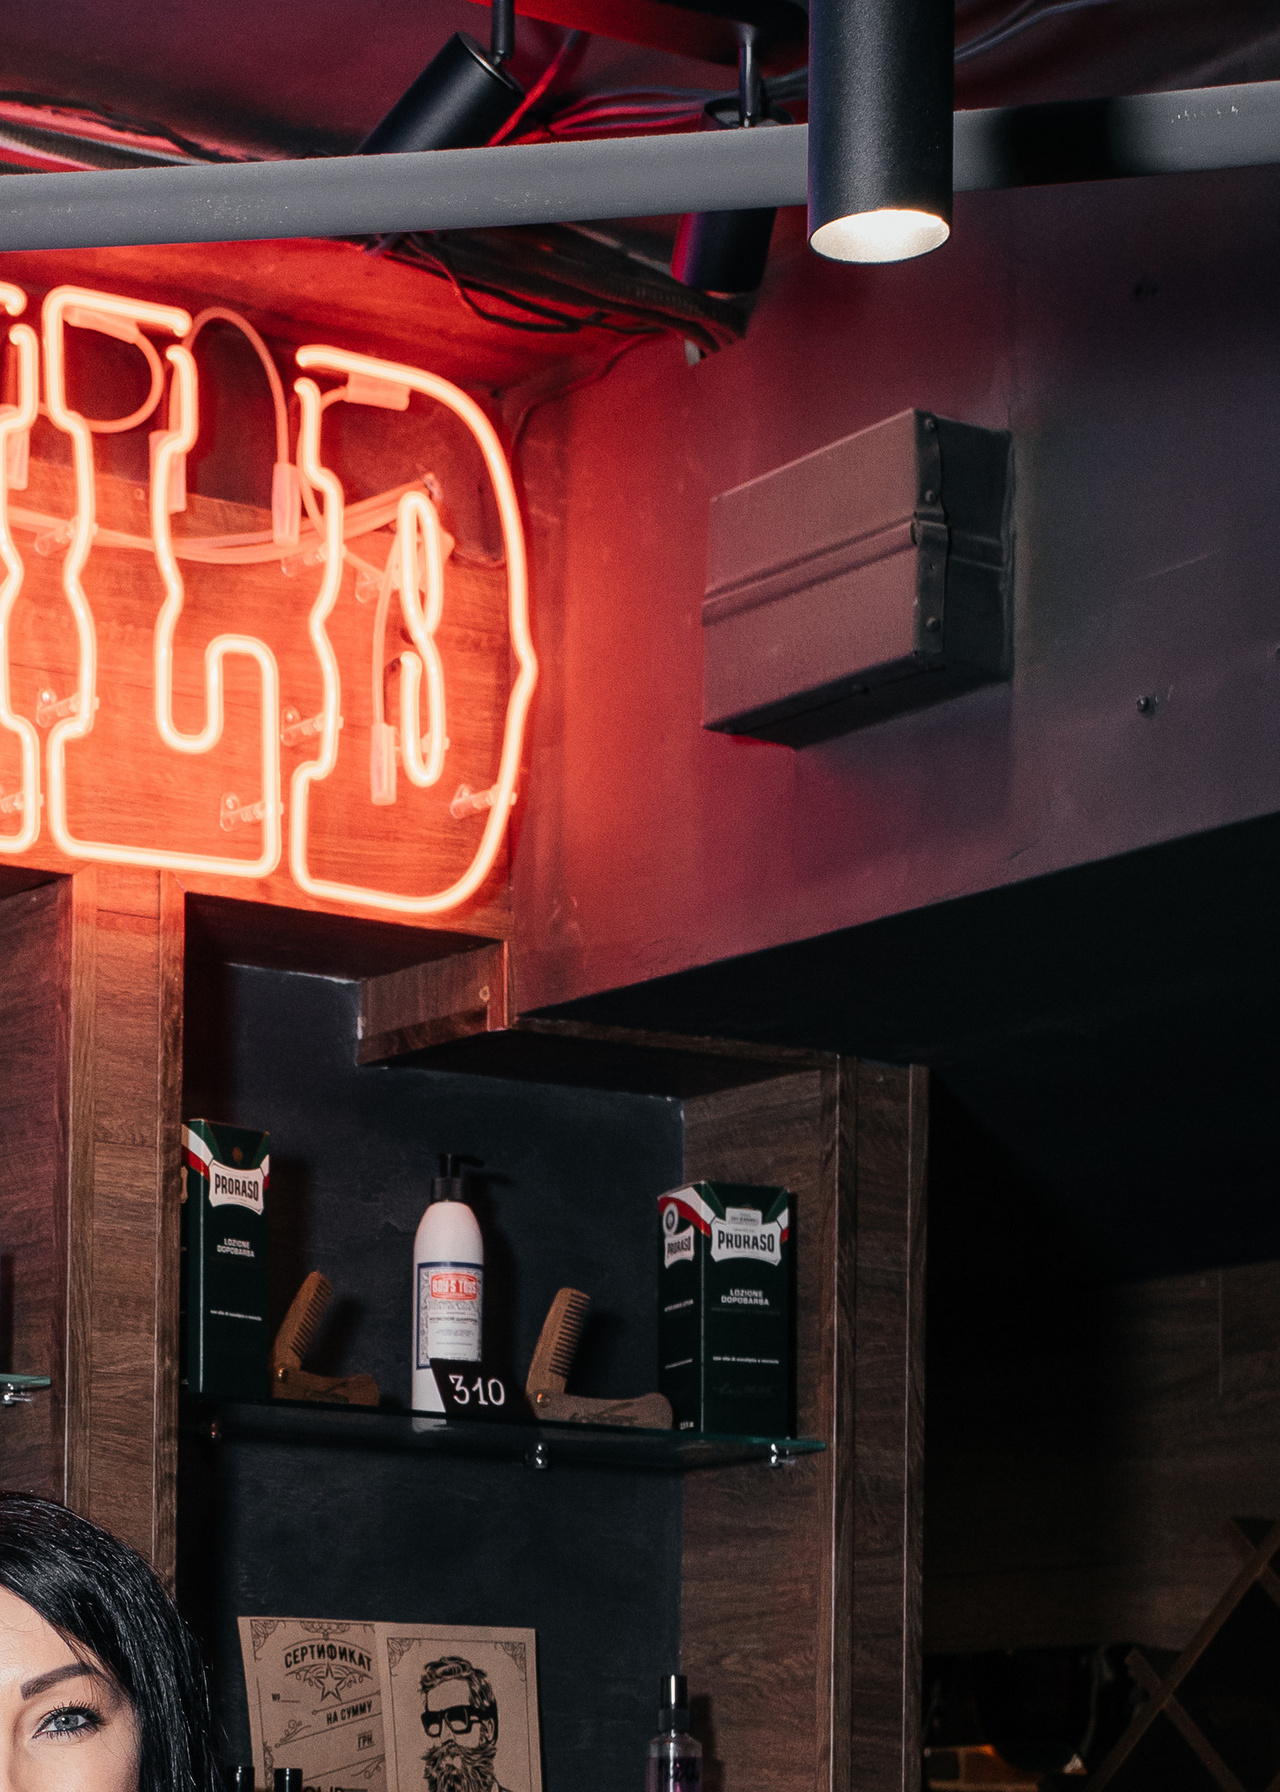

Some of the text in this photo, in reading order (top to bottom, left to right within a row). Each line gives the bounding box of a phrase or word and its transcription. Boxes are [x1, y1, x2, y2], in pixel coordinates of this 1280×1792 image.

[214, 1173, 260, 1201] PRORASO
[223, 1237, 251, 1250] LOZIONE
[717, 1230, 775, 1253] PRORASO
[729, 1288, 764, 1298] LOZIONE
[449, 1374, 505, 1405] 310
[284, 1643, 372, 1672] СЕРТИФИКАТ
[326, 1700, 373, 1725] НА СУММУ
